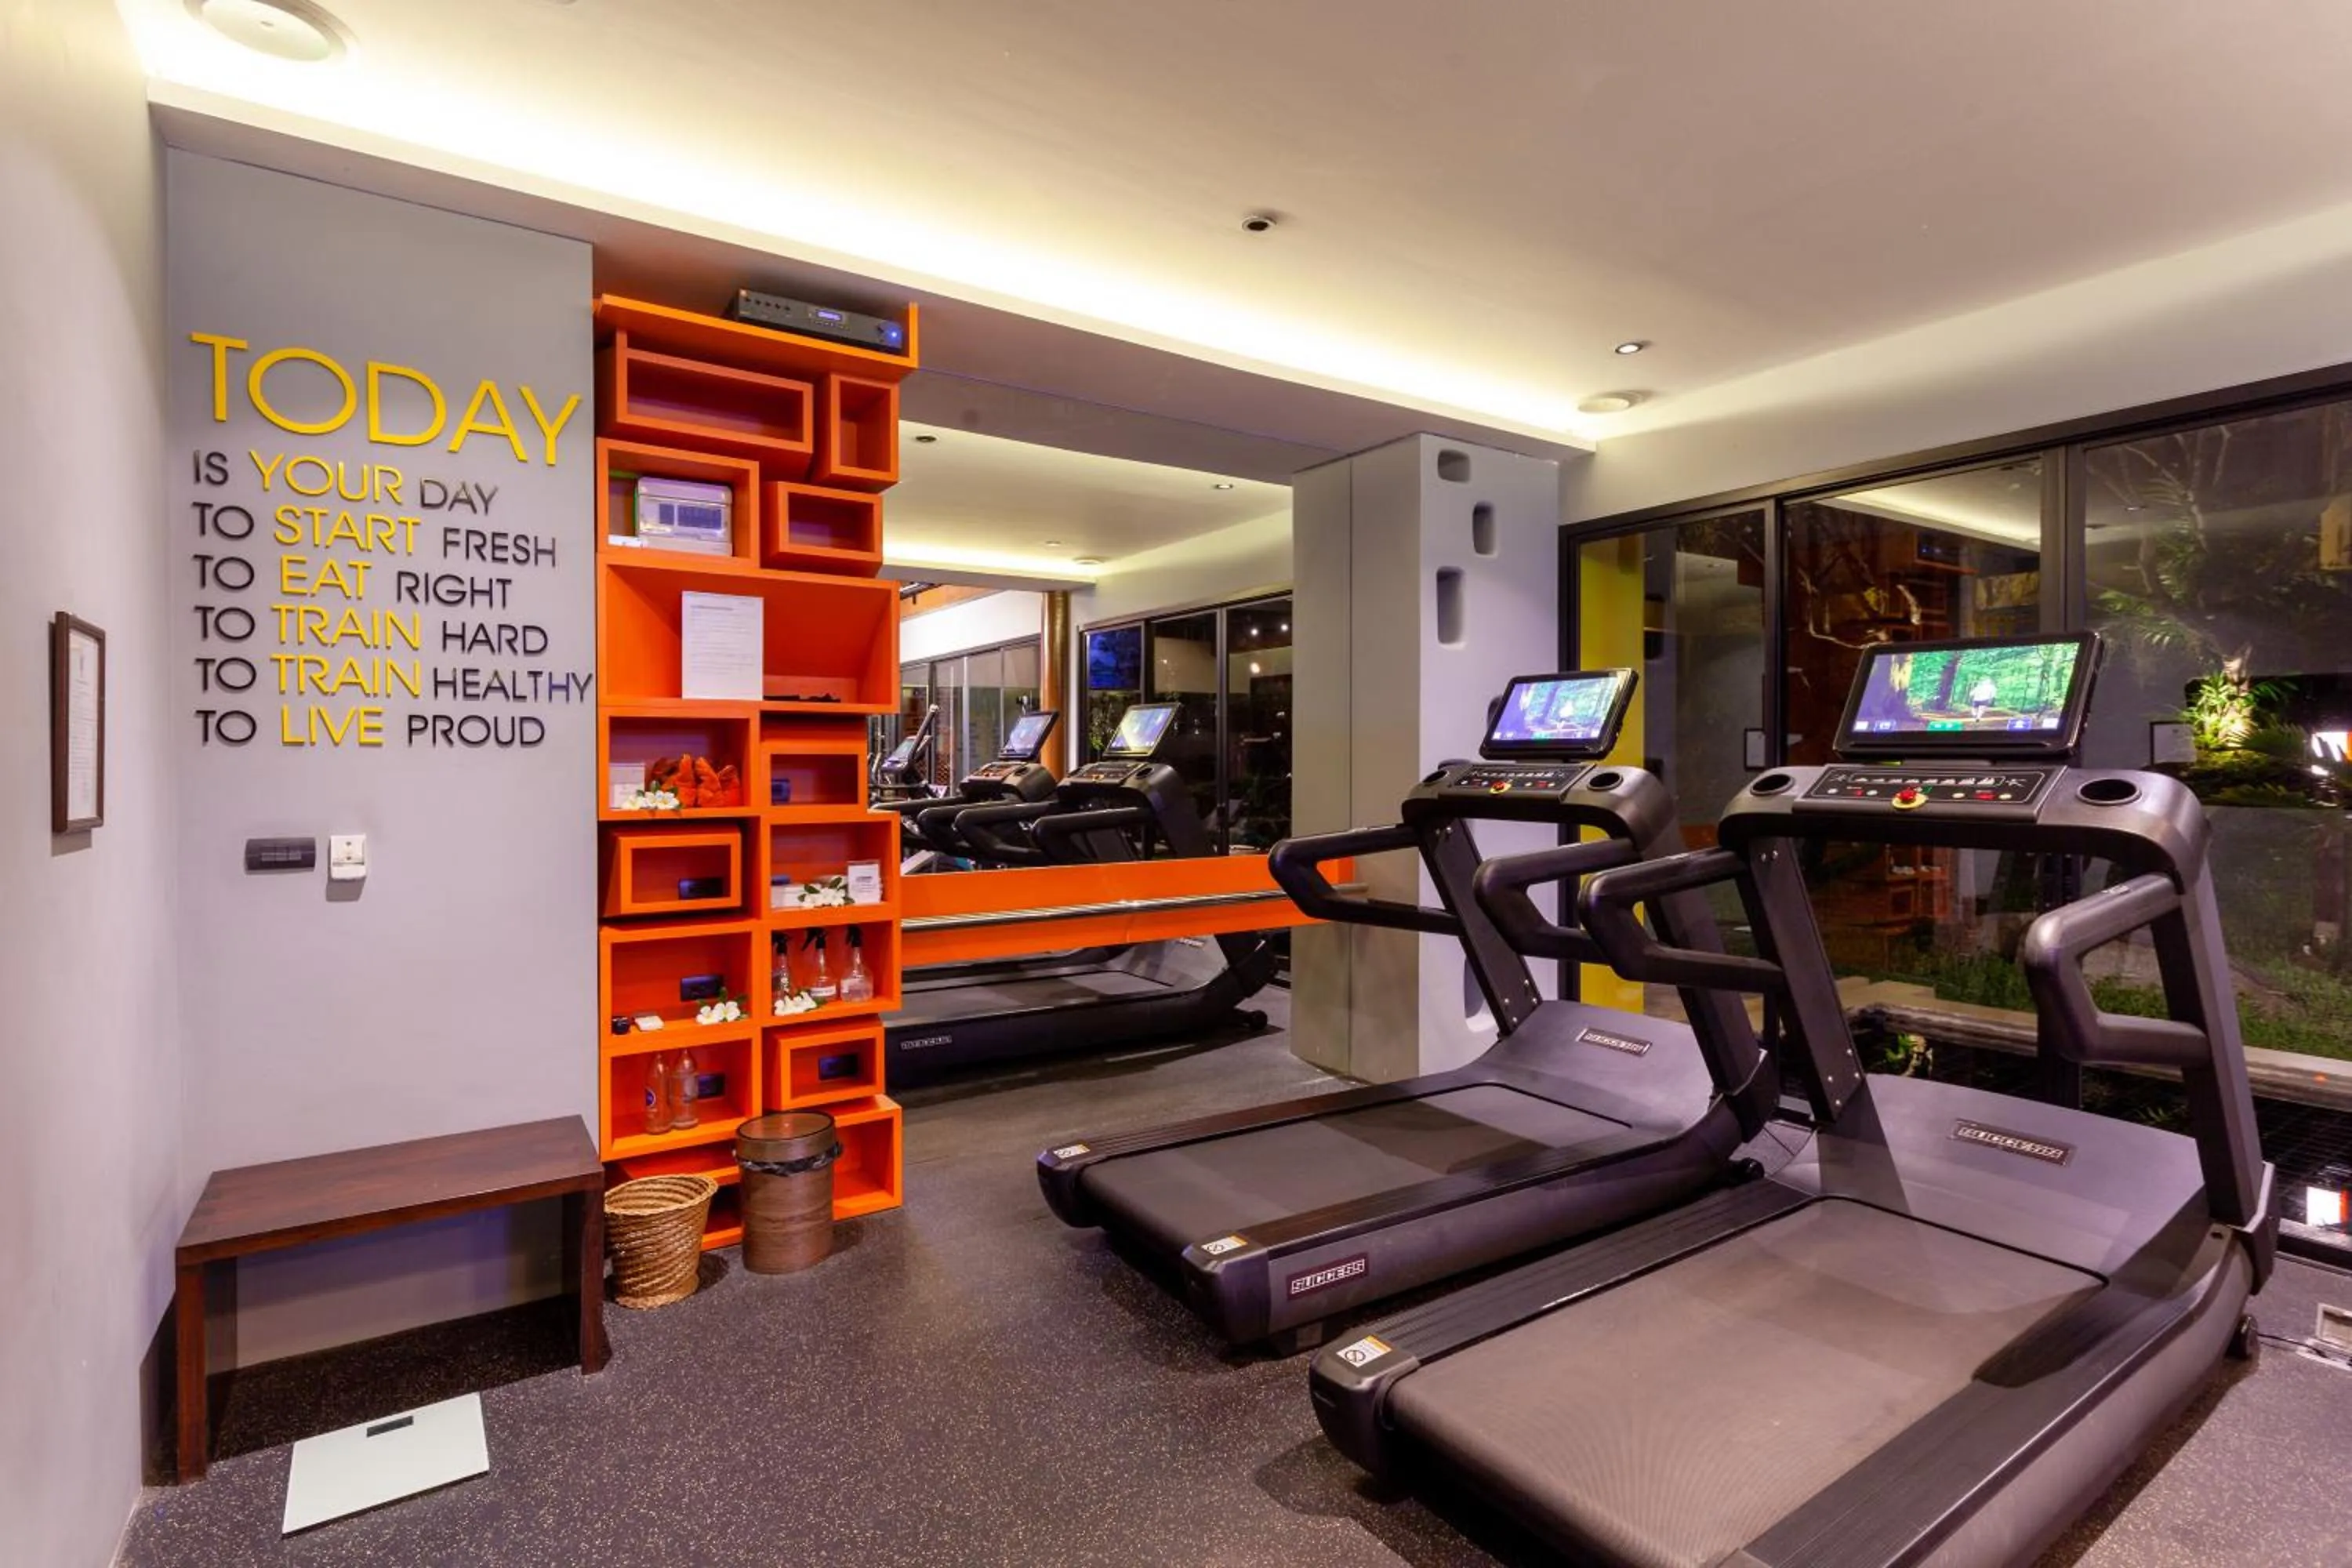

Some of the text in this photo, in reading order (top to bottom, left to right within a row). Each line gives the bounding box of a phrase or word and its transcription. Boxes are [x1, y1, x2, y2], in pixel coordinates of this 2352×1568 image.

[190, 332, 582, 466] TODAY
[193, 450, 499, 516] IS YOUR DAY
[191, 501, 556, 568] TO START FRESH
[192, 554, 513, 611] TO EAT RIGHT
[194, 604, 549, 657] TO TRAIN HARD
[194, 653, 593, 703] TO TRAIN HEALTHY
[194, 706, 546, 748] TO LIVE PROUD
[1291, 1258, 1365, 1294] SUCCESS
